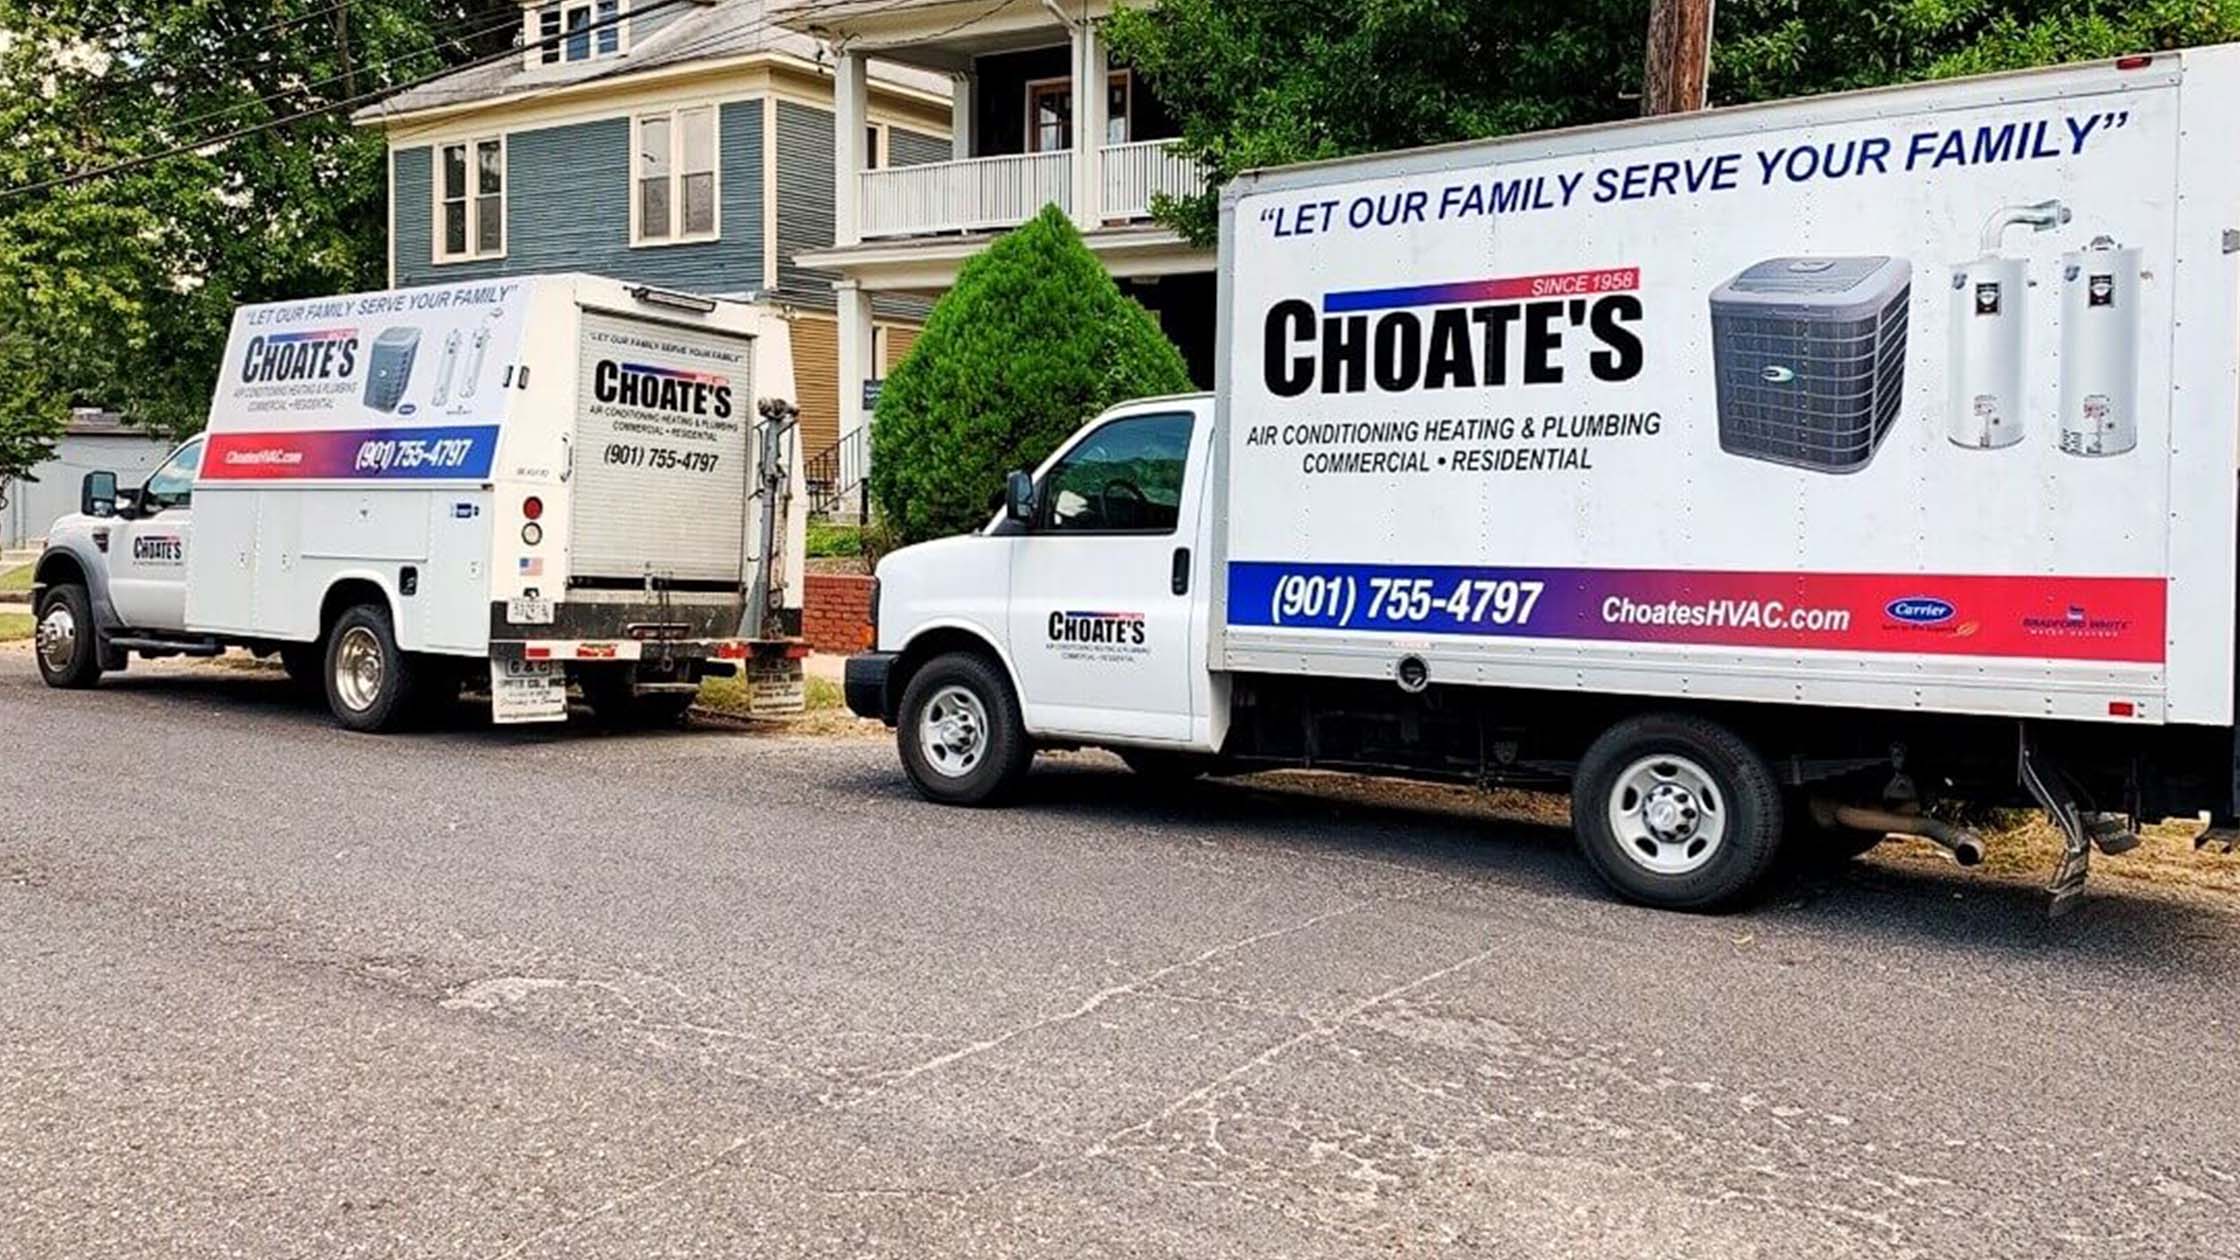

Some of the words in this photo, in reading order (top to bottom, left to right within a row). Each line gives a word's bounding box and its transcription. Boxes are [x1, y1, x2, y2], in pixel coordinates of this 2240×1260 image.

[1349, 192, 1427, 229] OUR
[1438, 172, 1584, 219] FAMILY
[1592, 153, 1742, 202] SERVE
[1756, 137, 1891, 186] YOUR
[1532, 277, 1589, 297] SINCE
[1592, 271, 1634, 292] 1958
[276, 307, 306, 324] OUR
[305, 302, 354, 321] FAMILY
[358, 295, 403, 316] SERVE
[408, 292, 451, 311] YOUR
[242, 335, 359, 384] CHOATE'S
[630, 338, 659, 350] FAMILY
[1263, 294, 1644, 398] CHOATE'S
[594, 359, 732, 419] CHOATE'S
[590, 405, 603, 415] AIR
[604, 406, 660, 423] CONDITIONING
[661, 413, 693, 427] HEATING
[702, 419, 738, 433] PLUMBING
[612, 421, 664, 436] COMMERCIAL
[671, 427, 718, 442] RESIDENTIAL
[1247, 425, 1278, 447] AIR
[1282, 420, 1419, 446] CONDITIONING
[1424, 417, 1516, 442] HEATING
[1520, 416, 1537, 439] &
[1542, 412, 1662, 439] PLUMBING
[356, 440, 396, 470] (901)
[395, 440, 473, 467] 755-4797
[604, 444, 645, 467] (901)
[649, 448, 719, 473] 755-4797
[1303, 451, 1430, 474] COMMERCIAL
[1451, 447, 1593, 471] RESIDENTIAL
[1272, 575, 1357, 627] (901)
[1367, 577, 1545, 625] 755-4797
[1602, 596, 1850, 631] ChoatesHVAC.com
[1895, 602, 1948, 616] Carrier
[1048, 610, 1145, 645] CHOATE'S
